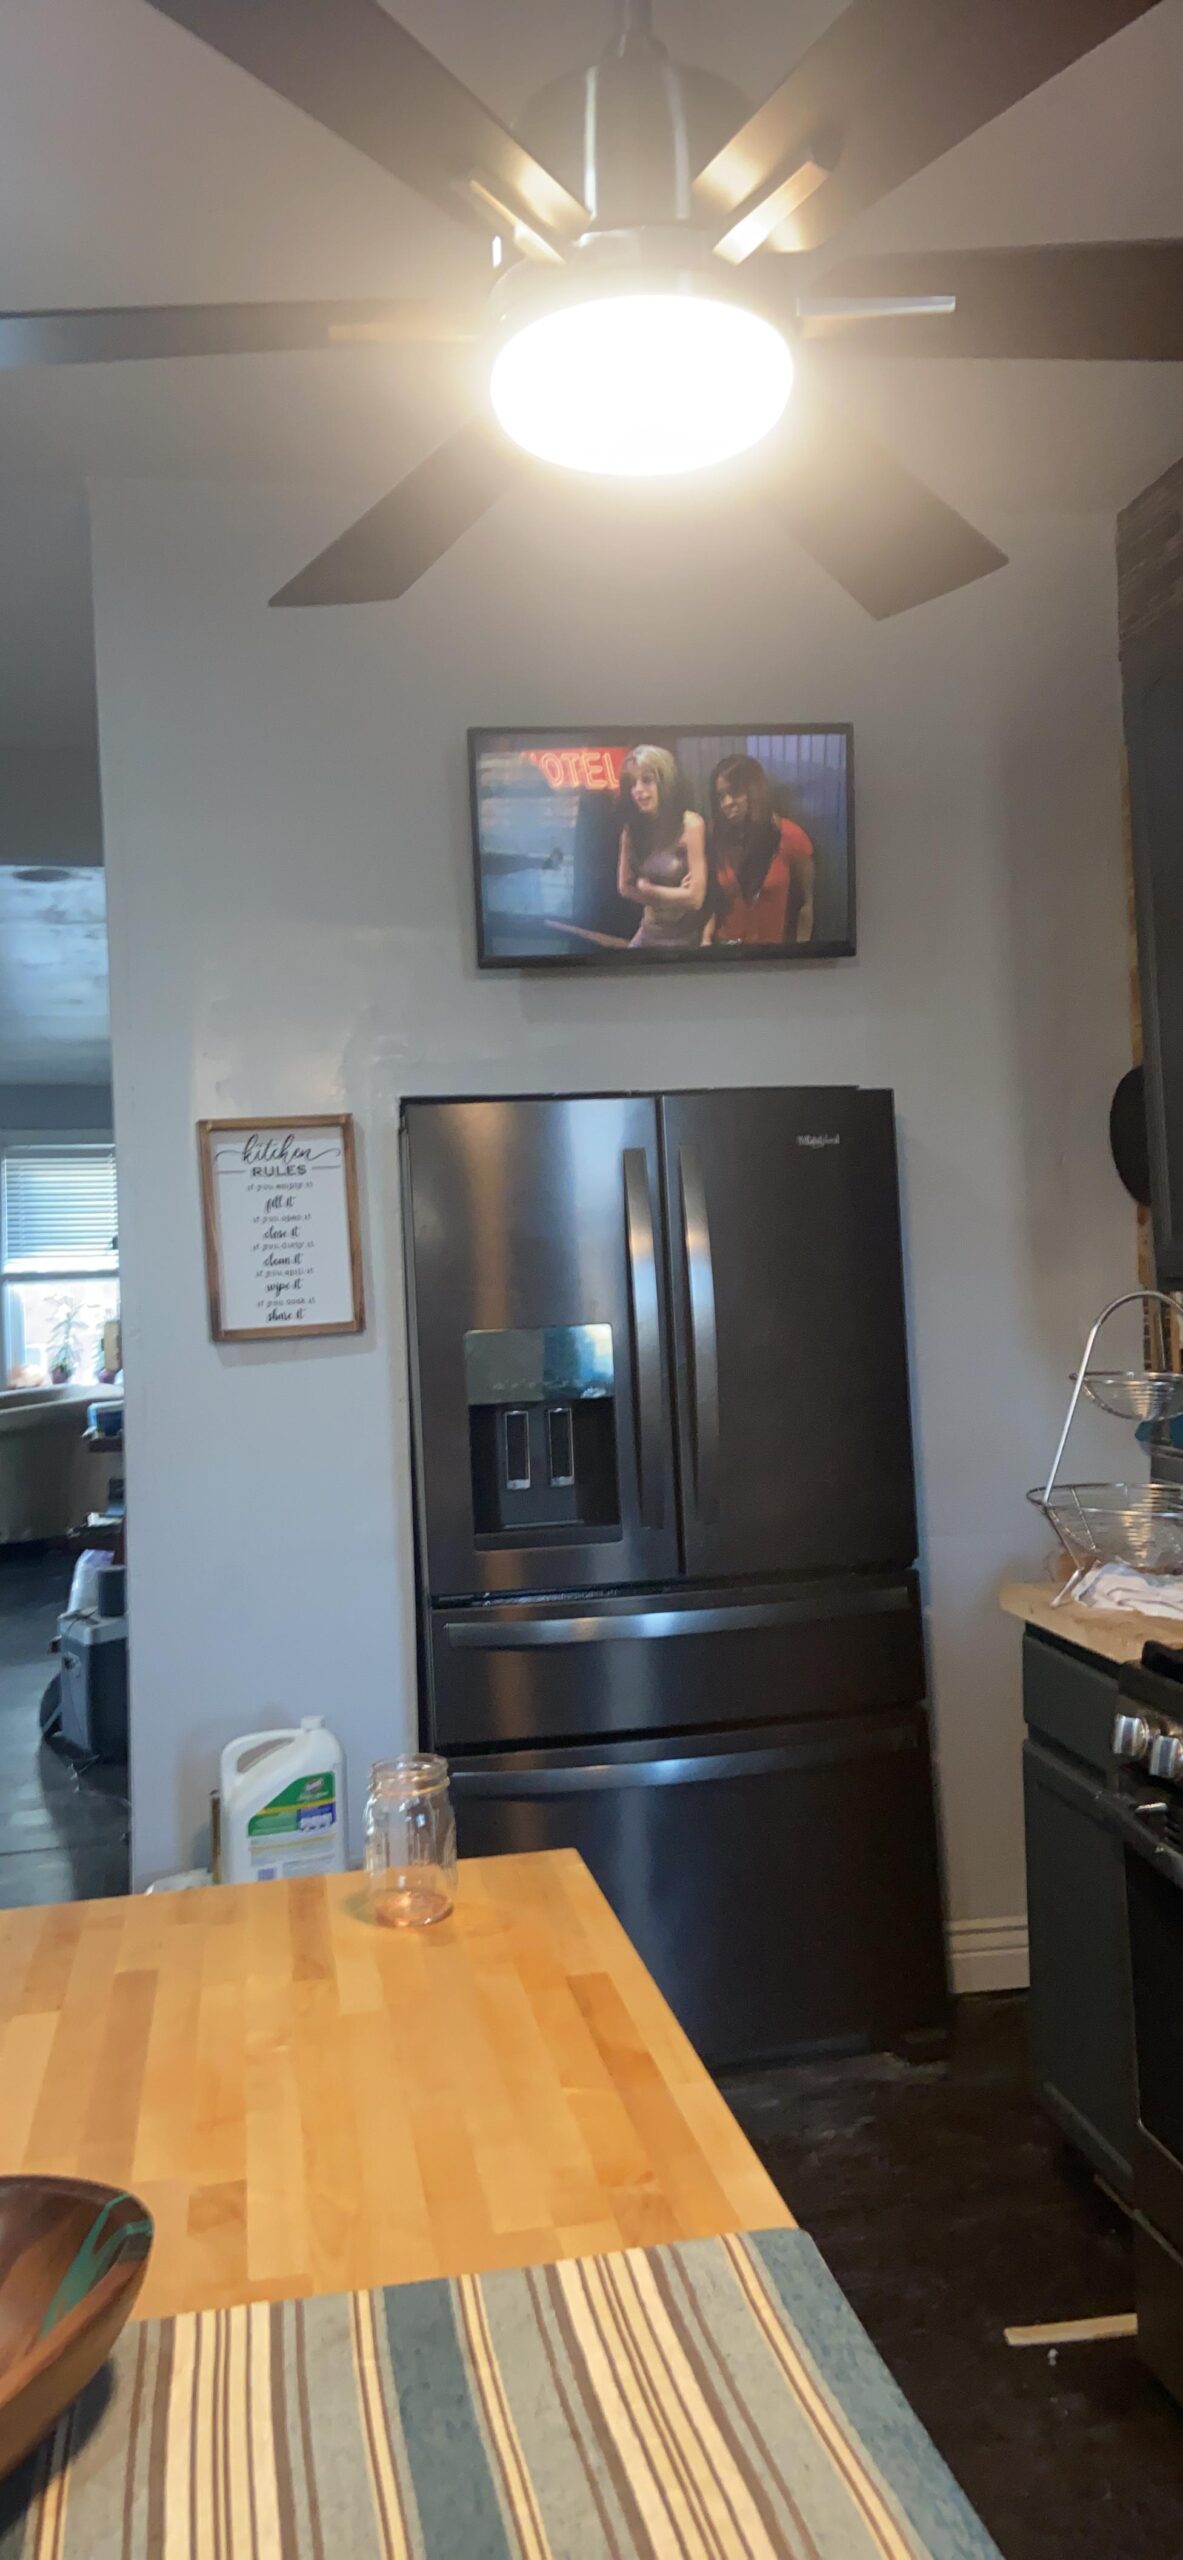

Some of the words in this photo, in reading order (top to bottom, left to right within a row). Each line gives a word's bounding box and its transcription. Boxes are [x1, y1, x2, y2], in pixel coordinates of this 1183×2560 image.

[522, 749, 620, 790] OTEL
[234, 1133, 322, 1165] kitchen
[252, 1164, 307, 1177] RULES
[286, 1195, 296, 1208] it
[263, 1225, 287, 1239] close
[291, 1226, 300, 1237] it
[263, 1252, 290, 1267] clean
[294, 1252, 303, 1265] it
[266, 1282, 289, 1297] wipe
[294, 1278, 303, 1289] it
[267, 1308, 292, 1321] share
[296, 1308, 306, 1319] it
